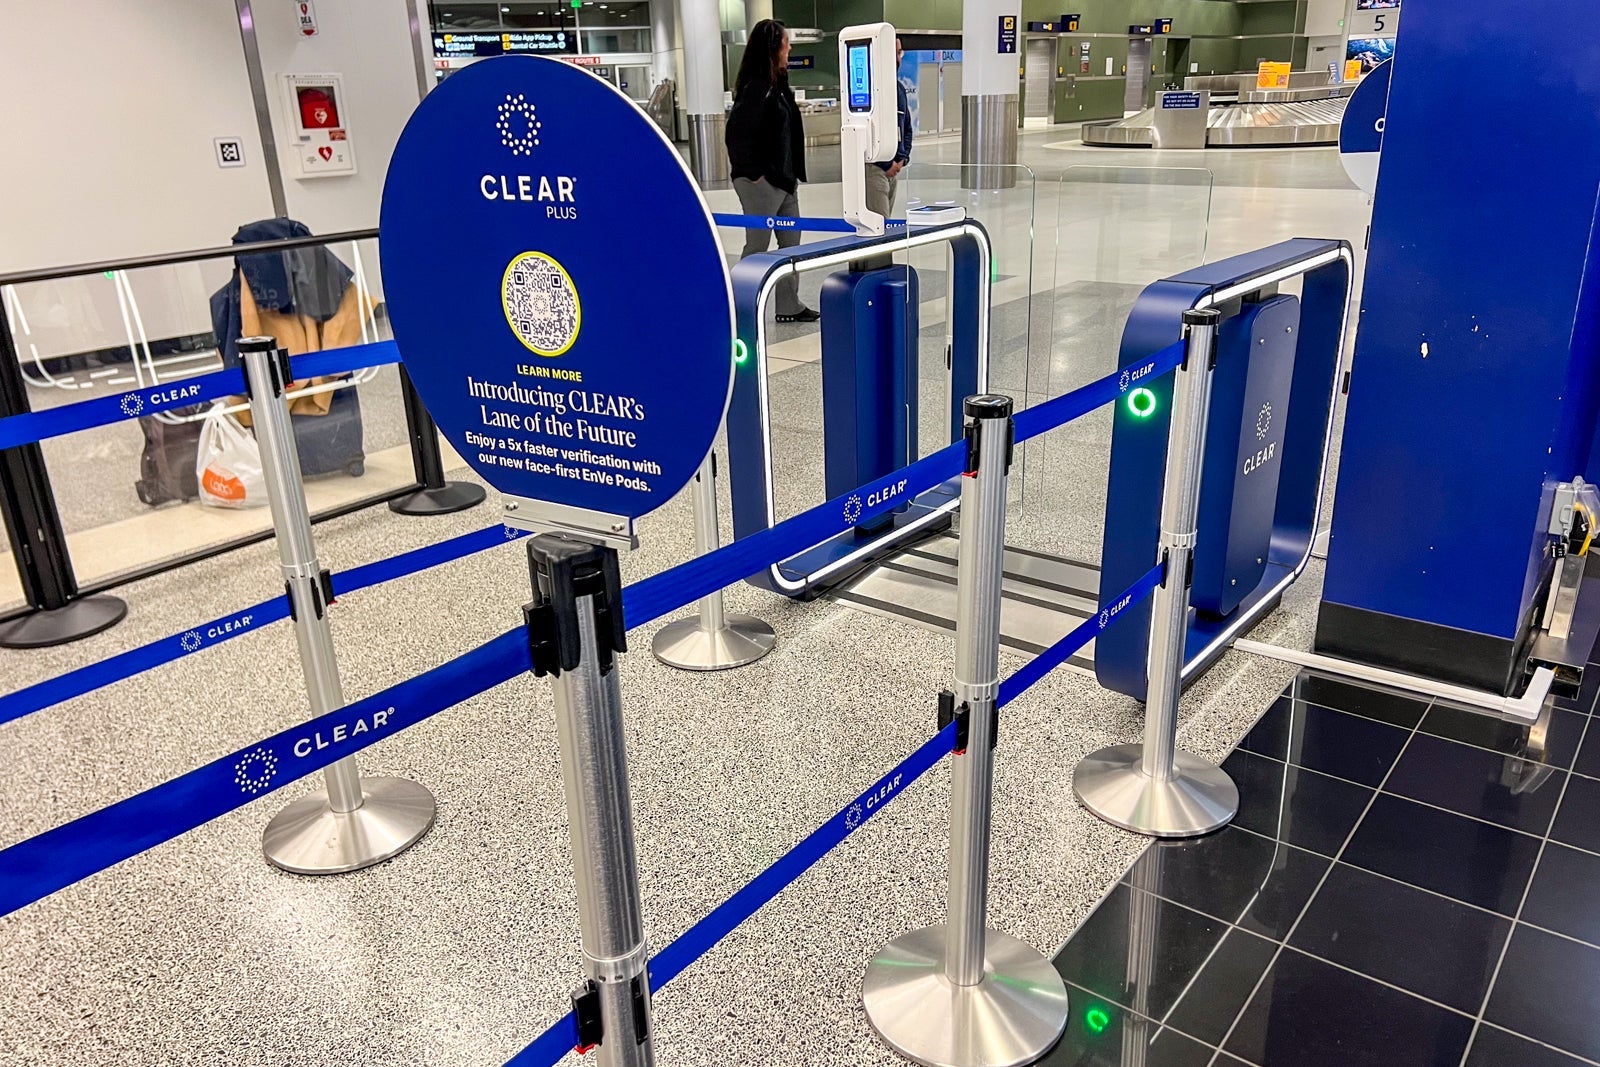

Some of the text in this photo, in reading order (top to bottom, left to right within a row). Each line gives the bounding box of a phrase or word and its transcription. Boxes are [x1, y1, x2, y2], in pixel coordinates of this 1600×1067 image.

[1374, 14, 1386, 31] 5
[546, 205, 577, 220] PLUS
[517, 364, 583, 382] LEARN MORE
[467, 376, 645, 421] Introducing CLEAR's
[480, 404, 637, 448] Lane of the Future
[465, 431, 662, 476] Enjoy a 5x faster verification with
[478, 452, 652, 492] our new face-first EnVe Pods.
